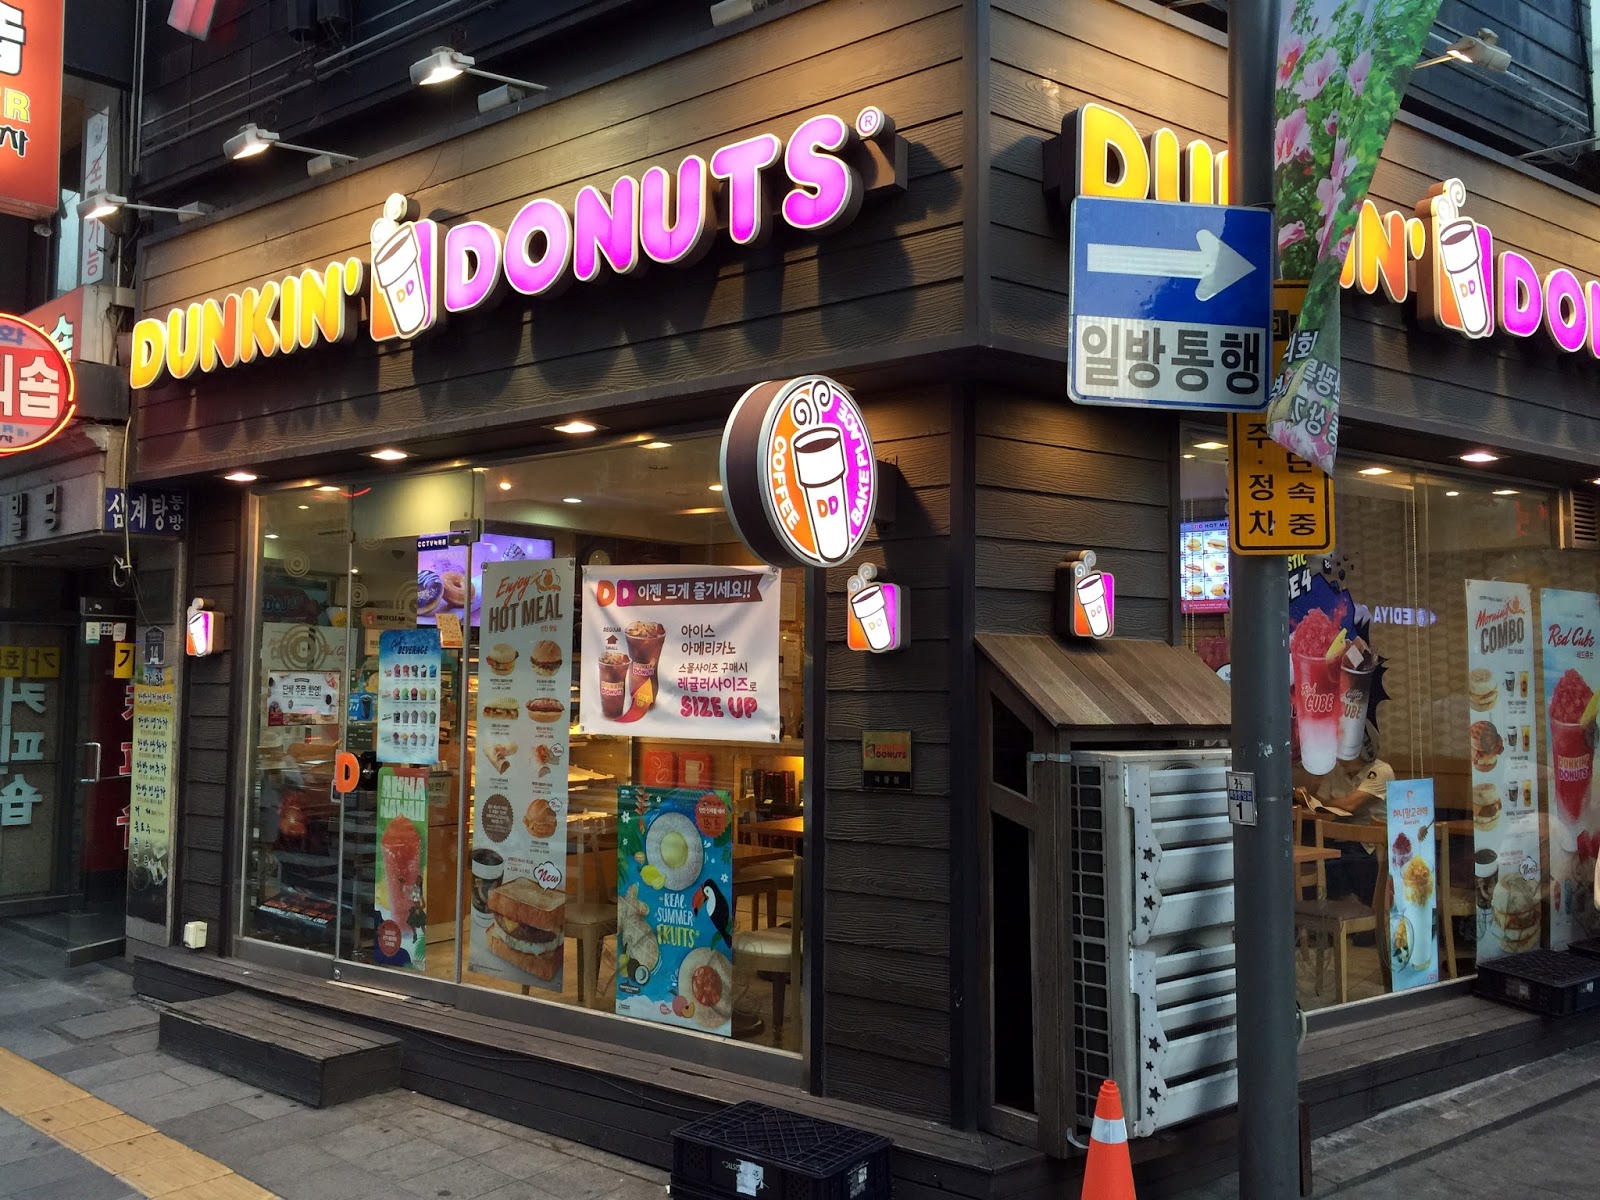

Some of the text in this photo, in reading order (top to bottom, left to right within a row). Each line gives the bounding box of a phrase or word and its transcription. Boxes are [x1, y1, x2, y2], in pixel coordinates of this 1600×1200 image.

[444, 113, 858, 312] DONUTS
[396, 279, 415, 304] DD
[1459, 279, 1476, 298] DD
[130, 257, 362, 389] DUNKIN'
[1081, 324, 1260, 395] 일방통행
[836, 401, 869, 468] PLACE
[772, 435, 801, 531] COFFEE
[816, 495, 839, 518] DD
[850, 470, 870, 528] BAKE
[496, 574, 531, 606] Enjoy
[637, 584, 662, 602] 이젠
[665, 582, 689, 600] 크게
[693, 579, 752, 600] 즐기세요!!
[489, 593, 563, 633] HOT MEAL
[681, 624, 716, 638] 아이스
[1481, 617, 1525, 655] COMBO
[1548, 624, 1595, 648] Red Cube
[397, 645, 429, 655] BEVERAGE
[681, 641, 736, 656] 아메리카노
[678, 662, 748, 674] 스몰사이즈 구매시
[677, 676, 757, 693] 레귤러사이즈로
[680, 695, 758, 719] SIZE UP
[1305, 692, 1335, 713] CUBE
[335, 752, 360, 793] D
[1558, 767, 1589, 781] DONUTS
[537, 868, 559, 884] New
[656, 907, 694, 927] SUMMER
[656, 923, 695, 949] FRUITS
